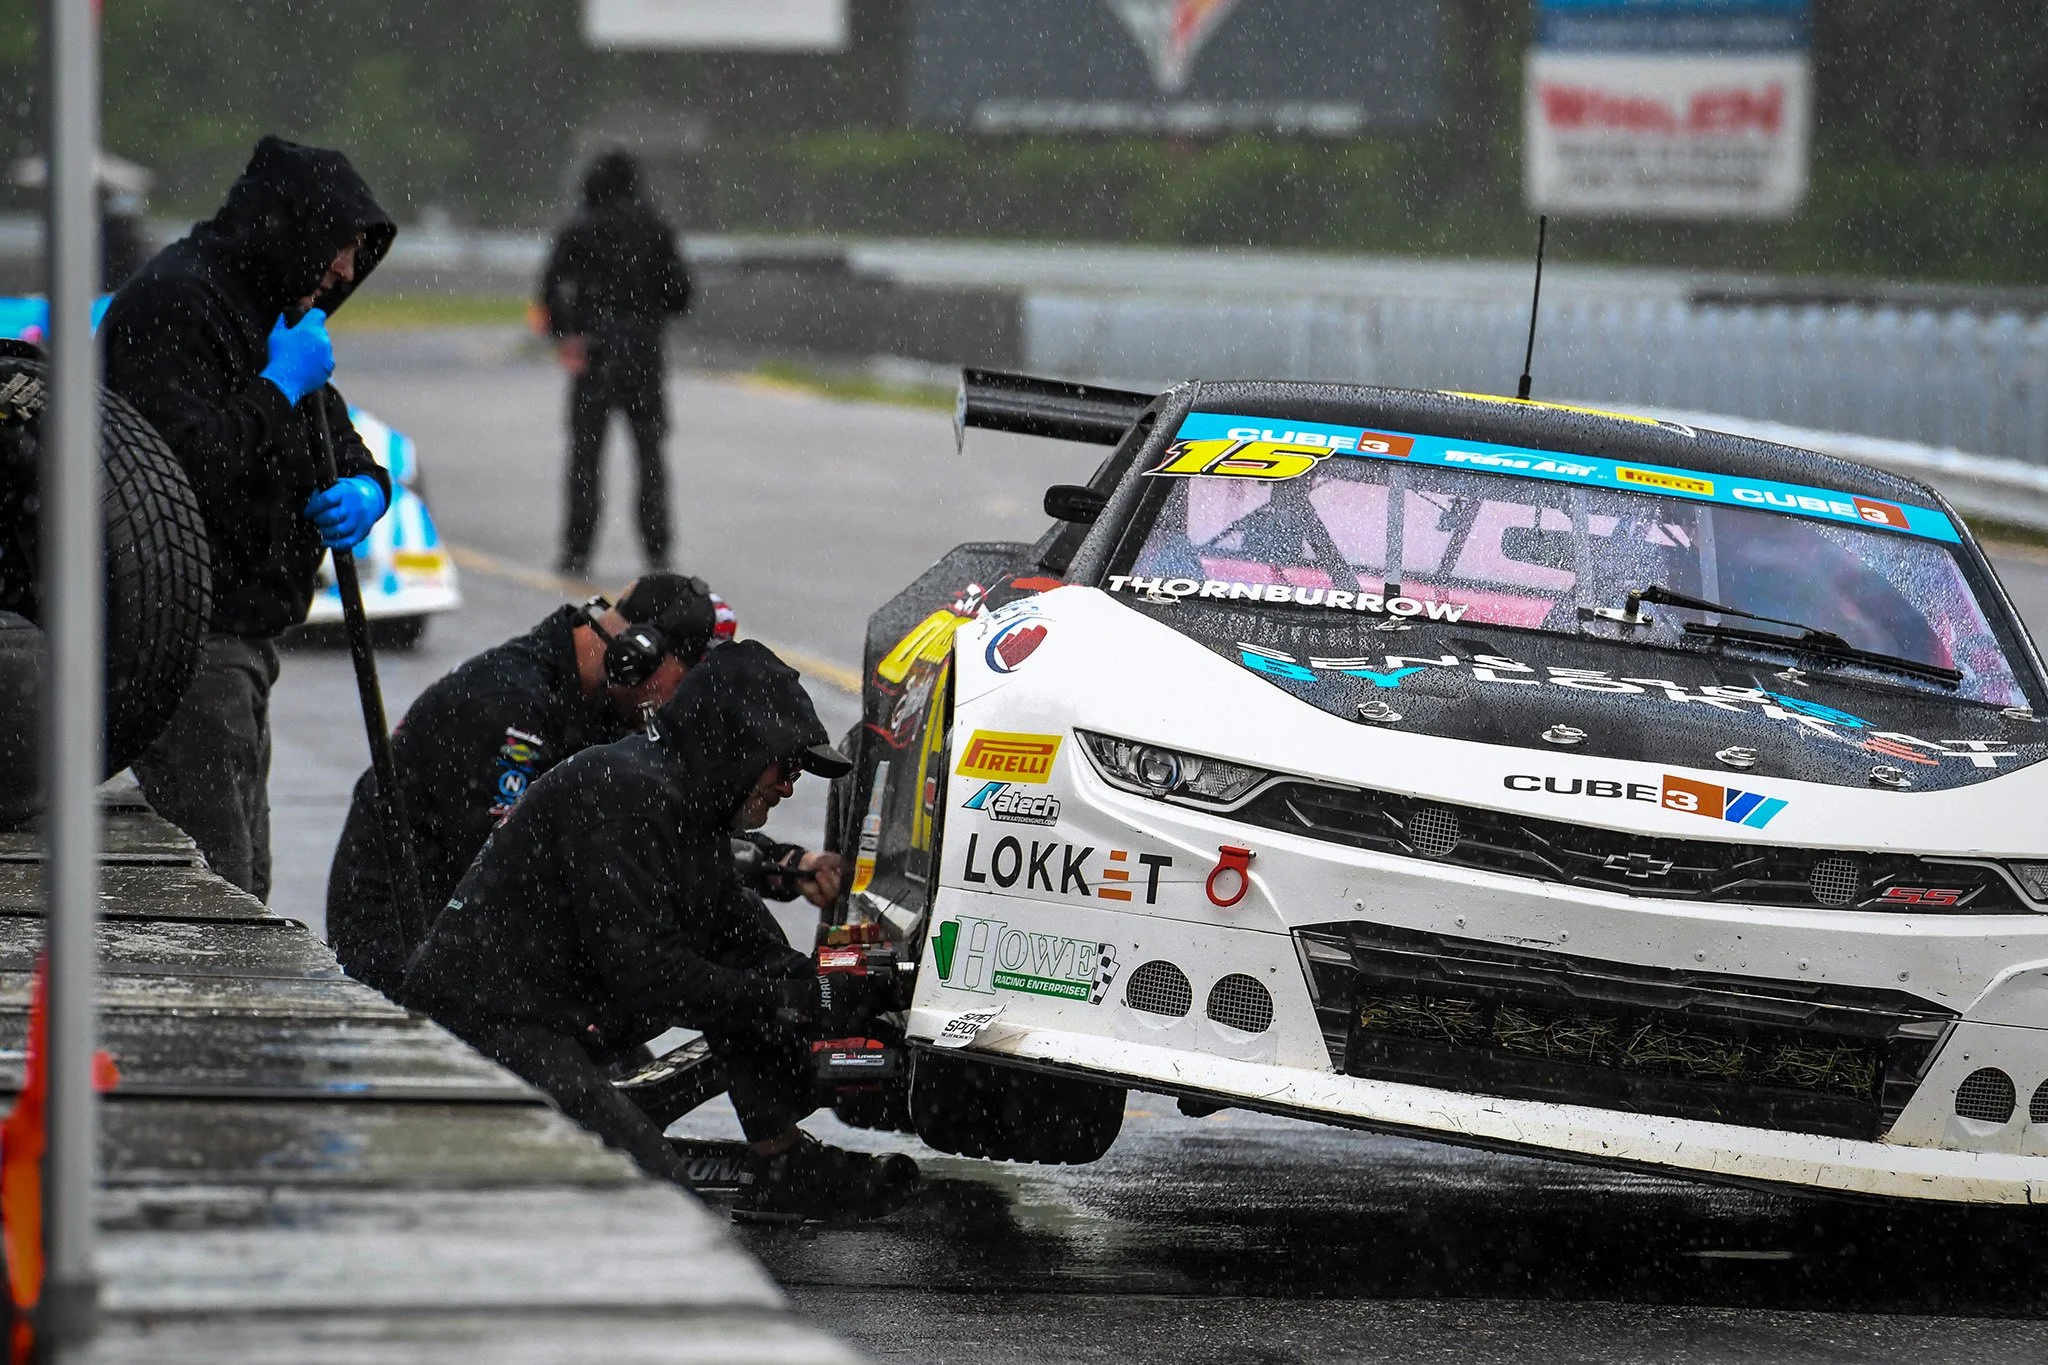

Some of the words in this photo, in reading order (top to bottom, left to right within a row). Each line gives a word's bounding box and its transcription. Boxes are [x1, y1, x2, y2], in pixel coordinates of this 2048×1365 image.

[1146, 439, 1336, 481] 15
[1444, 450, 1531, 470] Trans
[1731, 487, 1891, 525] CUBE3
[1108, 574, 1469, 624] THORNBURROW
[966, 738, 1053, 775] PIRELLI
[963, 781, 1061, 820] Katech
[1503, 773, 1700, 812] CUBE3
[963, 832, 1173, 905] LOKKET
[1875, 886, 1963, 906] SS
[942, 915, 1101, 995] HOWE
[994, 974, 1026, 988] RACING
[1026, 976, 1088, 998] ENTERPRISES
